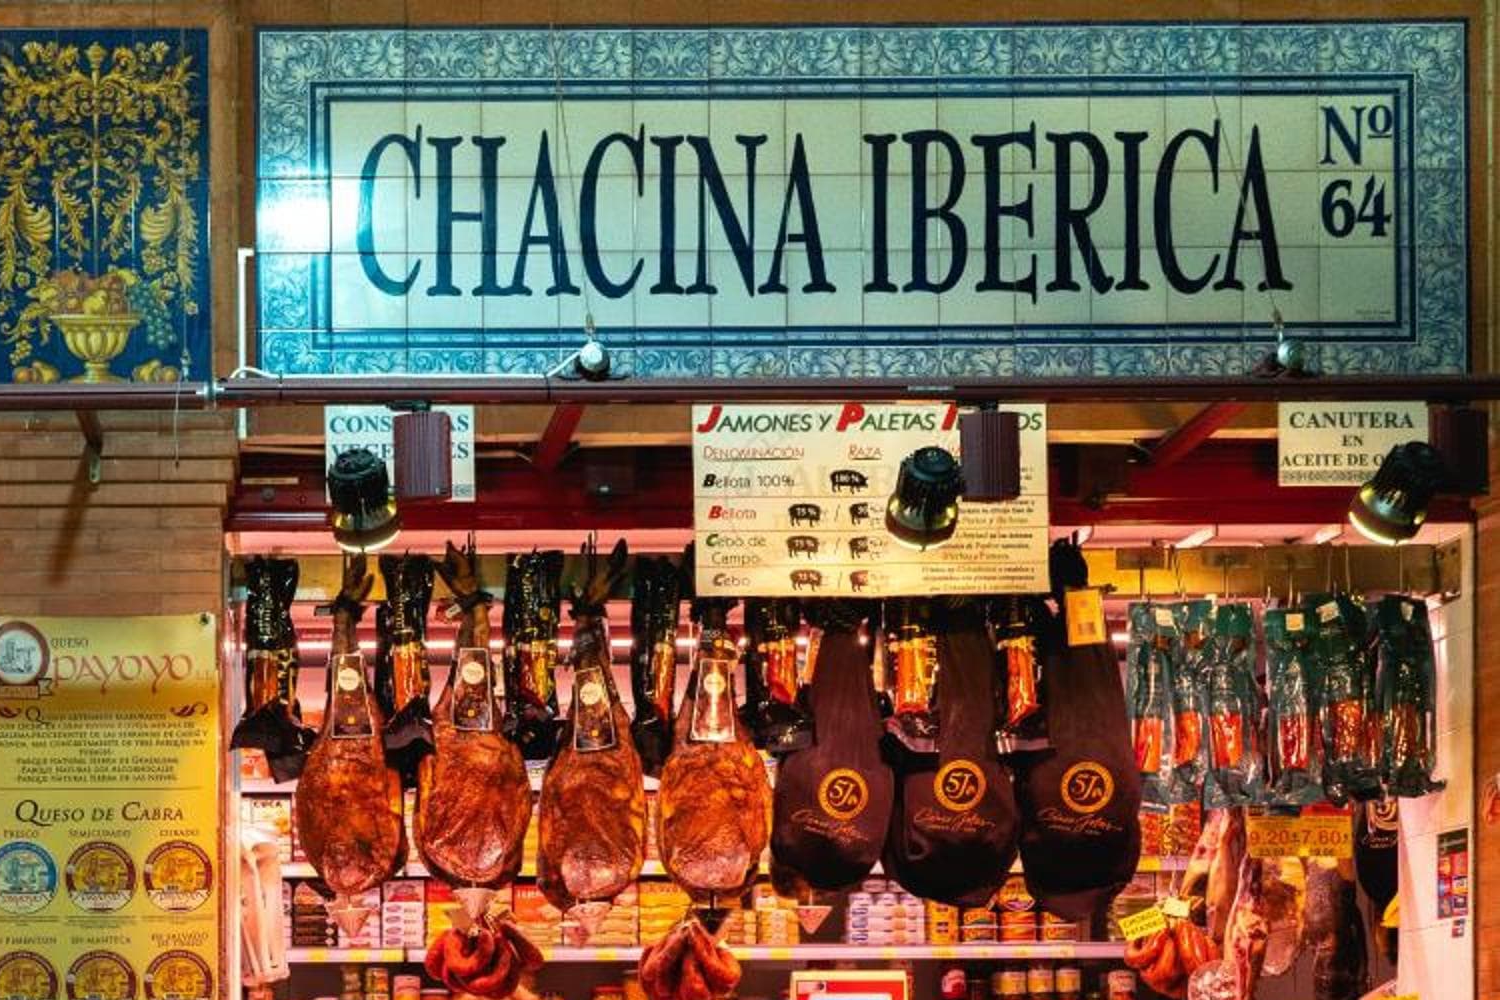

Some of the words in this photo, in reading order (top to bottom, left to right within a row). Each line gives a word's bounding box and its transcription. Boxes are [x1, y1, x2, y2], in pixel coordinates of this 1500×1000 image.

[357, 125, 837, 299] CHACINA
[862, 119, 1294, 305] IBERICA
[1320, 175, 1393, 239] 64
[696, 405, 812, 433] JAMONES
[819, 414, 833, 431] Y
[836, 402, 936, 432] PALETAS
[1289, 411, 1414, 429] CANUTERA
[1342, 434, 1364, 447] EN
[848, 444, 882, 459] RAZA
[1282, 453, 1343, 467] ACEITE
[1347, 453, 1369, 467] DE
[702, 473, 751, 489] Bellota
[757, 474, 795, 489] 100%
[707, 505, 757, 520] Bellota
[705, 533, 743, 548] Cebo
[711, 552, 760, 568] Campo
[712, 573, 750, 587] Cebo
[15, 799, 84, 827] QUESO
[92, 807, 113, 820] DE
[121, 801, 184, 821] CABRA
